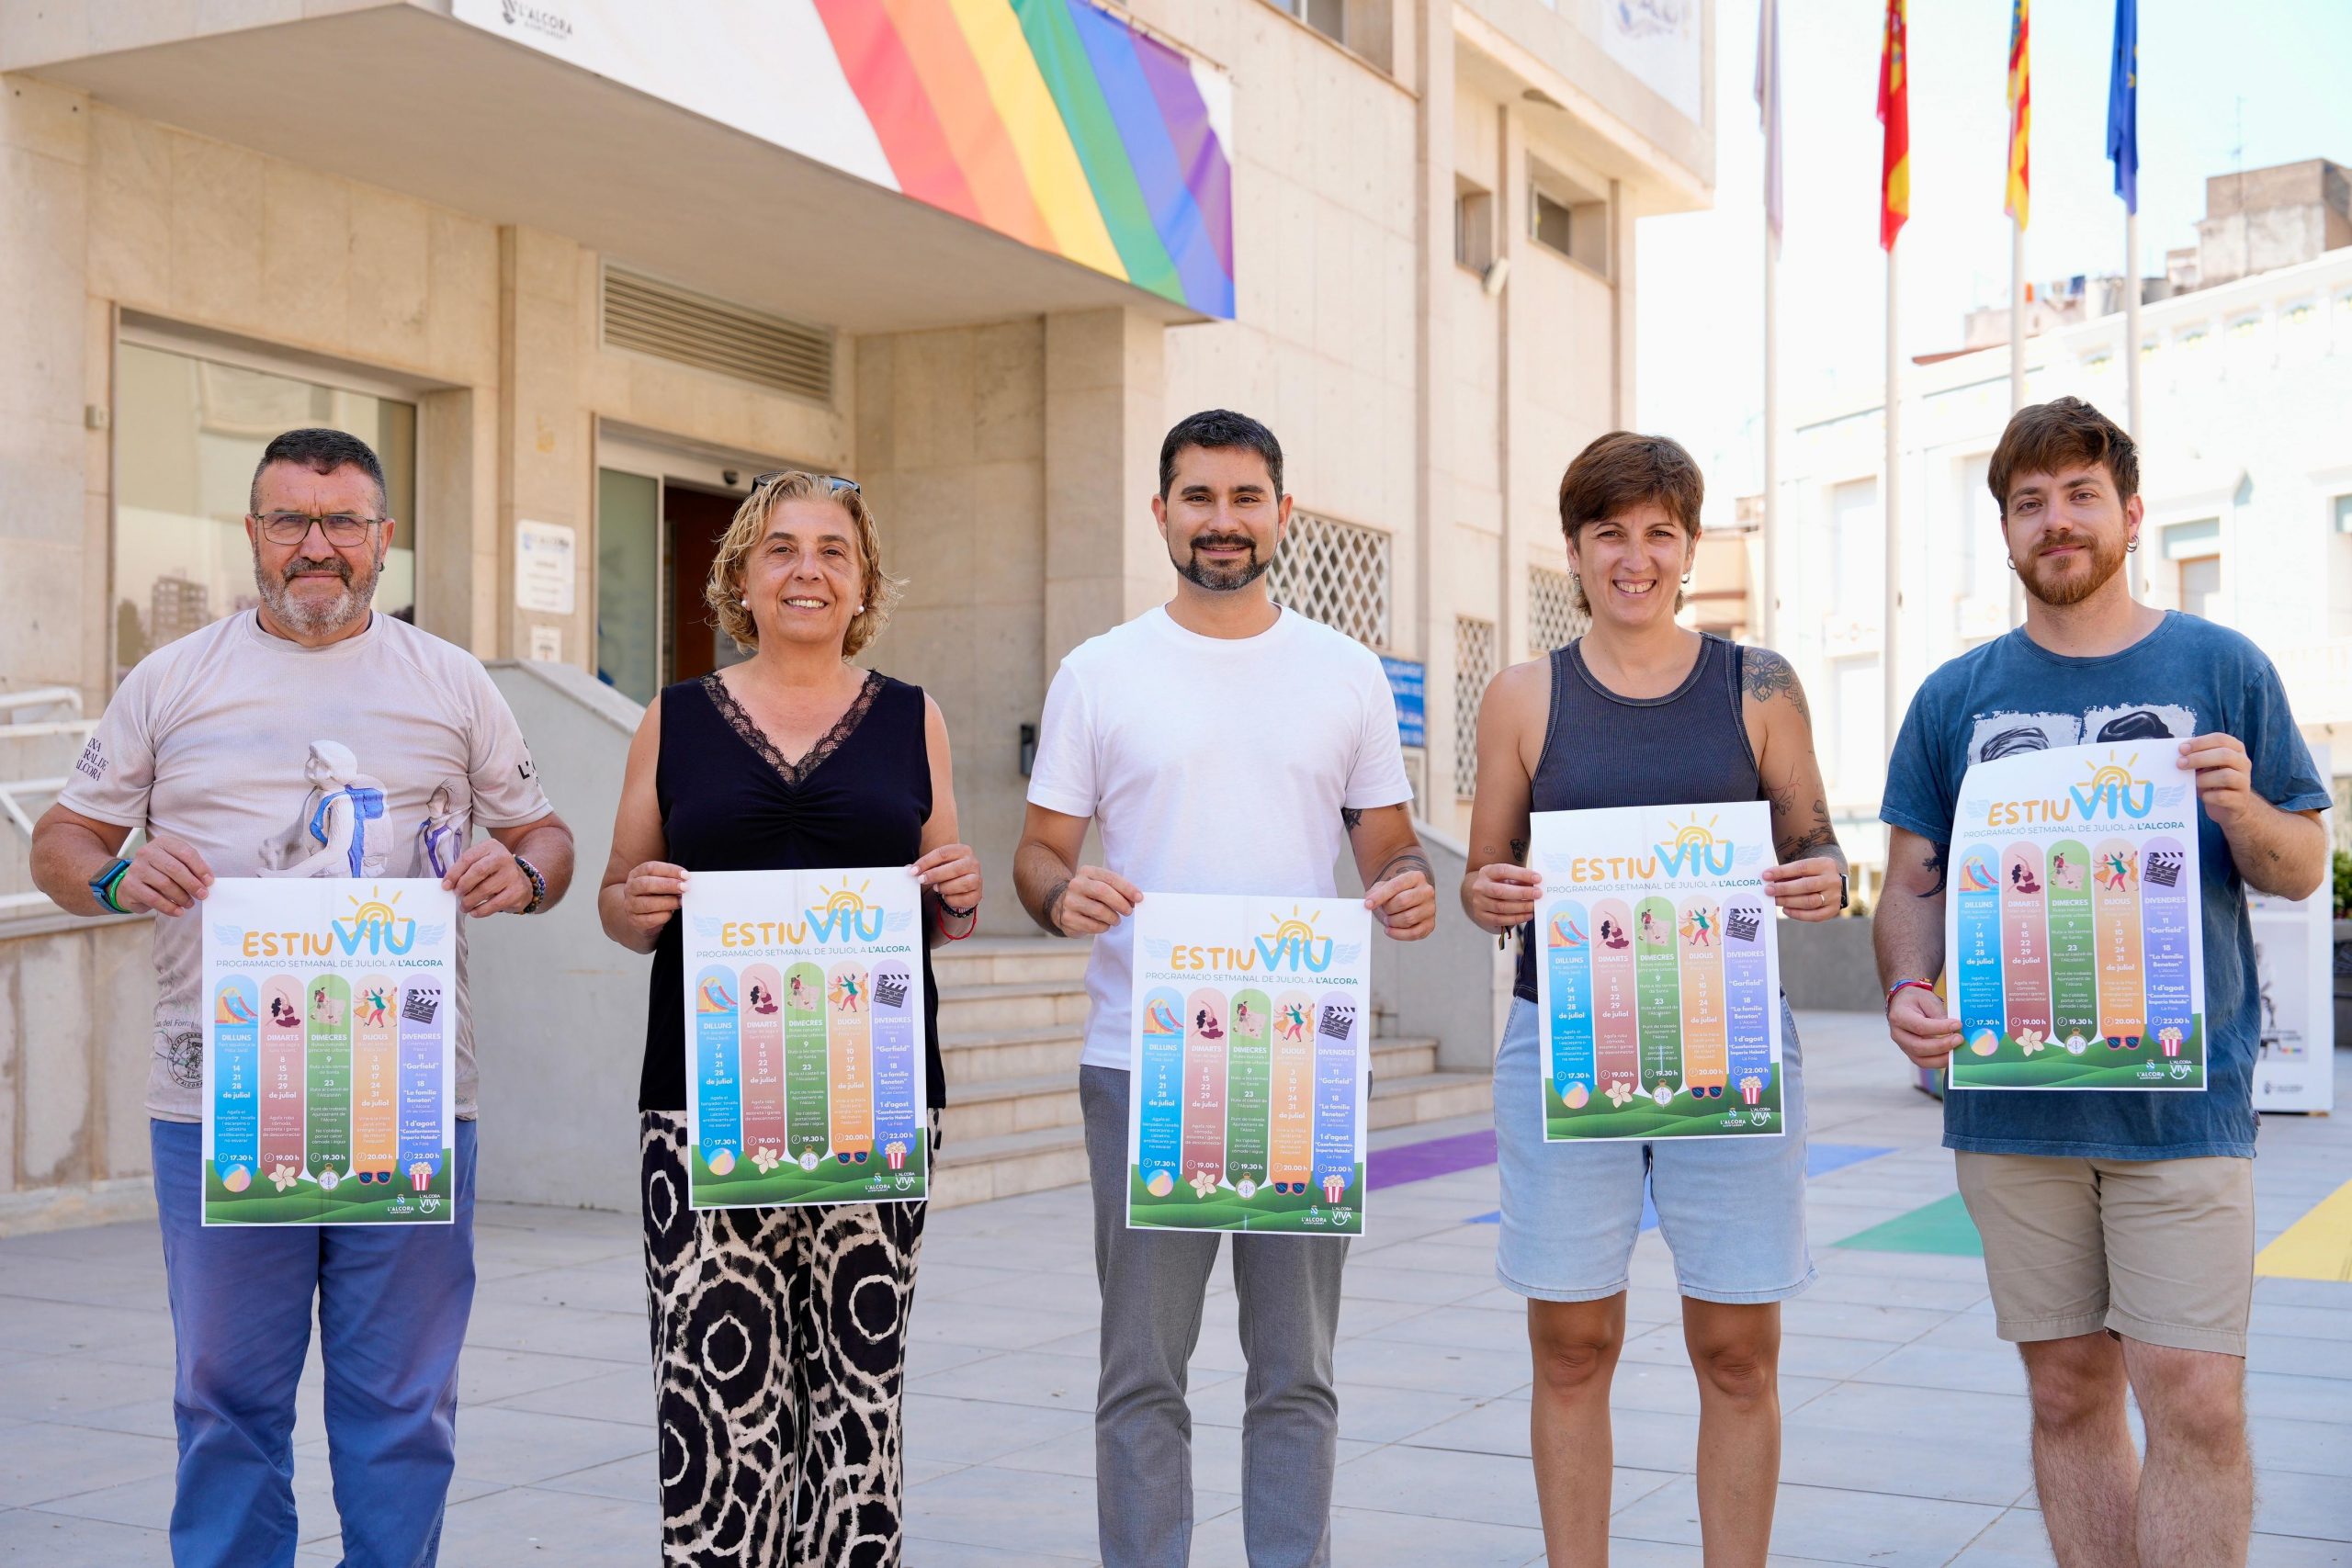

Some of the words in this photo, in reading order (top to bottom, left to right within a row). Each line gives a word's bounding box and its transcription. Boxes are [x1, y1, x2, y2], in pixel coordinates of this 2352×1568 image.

[2028, 825, 2075, 834] SETMANAL
[2078, 824, 2092, 832] DE
[2094, 823, 2128, 832] JULIOL
[2137, 820, 2185, 830] L'ALCORA
[1615, 882, 1661, 891] SETMANAL
[1679, 880, 1711, 888] JULIOL
[1718, 877, 1761, 888] L'ALCORA
[2052, 898, 2089, 907] DIMECRES
[2104, 897, 2131, 906] DIJOUS
[2144, 896, 2186, 904] DIVENDRES
[765, 948, 811, 956] SETMANAL
[814, 947, 827, 955] DE
[829, 946, 860, 954] JULIOL
[867, 944, 911, 953] L'ALCORA
[288, 960, 337, 968] SETMANAL
[398, 959, 444, 967] L'ALCORA
[1555, 956, 1584, 964] DILLUNS
[1213, 974, 1259, 983] SETMANAL
[1276, 976, 1307, 984] JULIOL
[1316, 976, 1359, 986] L'ALCORA
[874, 1016, 911, 1024] DIVENDRES
[1148, 1043, 1178, 1052] DILLUNS
[1318, 1048, 1355, 1056] DIVENDRES
[2170, 1065, 2192, 1074] VIVA
[1751, 1111, 1771, 1121] VIVA
[896, 1176, 915, 1186] VIVA
[420, 1199, 440, 1208] VIVA
[1332, 1211, 1351, 1221] VIVA
